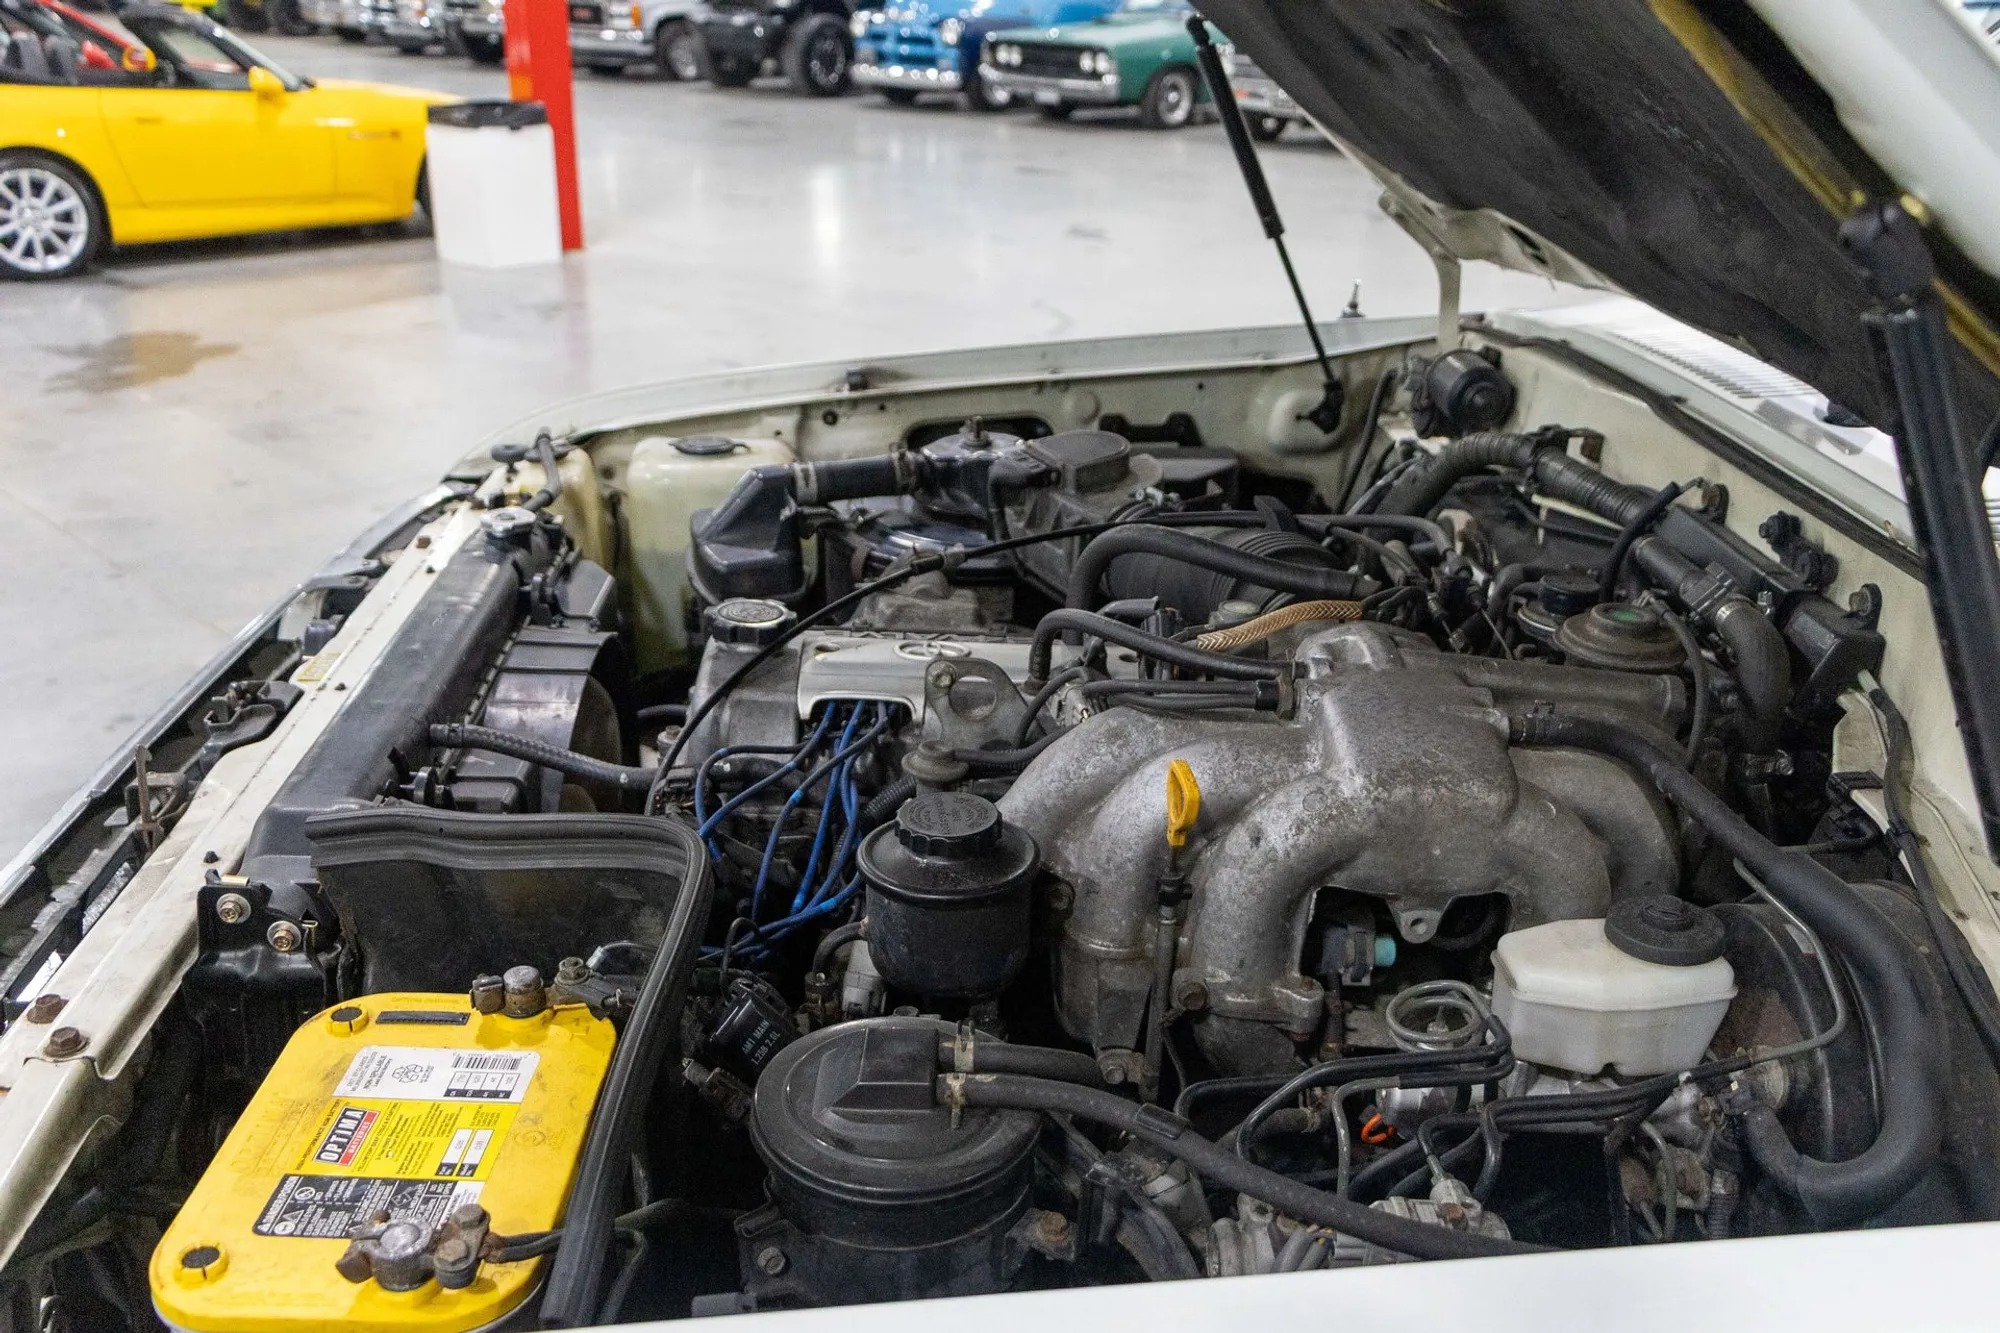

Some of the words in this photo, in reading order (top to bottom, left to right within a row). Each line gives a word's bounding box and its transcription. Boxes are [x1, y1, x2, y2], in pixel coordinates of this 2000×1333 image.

[742, 1038, 756, 1055] AM1
[752, 1020, 770, 1039] MAIN
[362, 1055, 387, 1088] NON-SPILLABLE
[319, 1110, 364, 1160] OPTIMA
[347, 1120, 372, 1153] BATTERIES
[261, 1176, 299, 1222] DANGER/POISON
